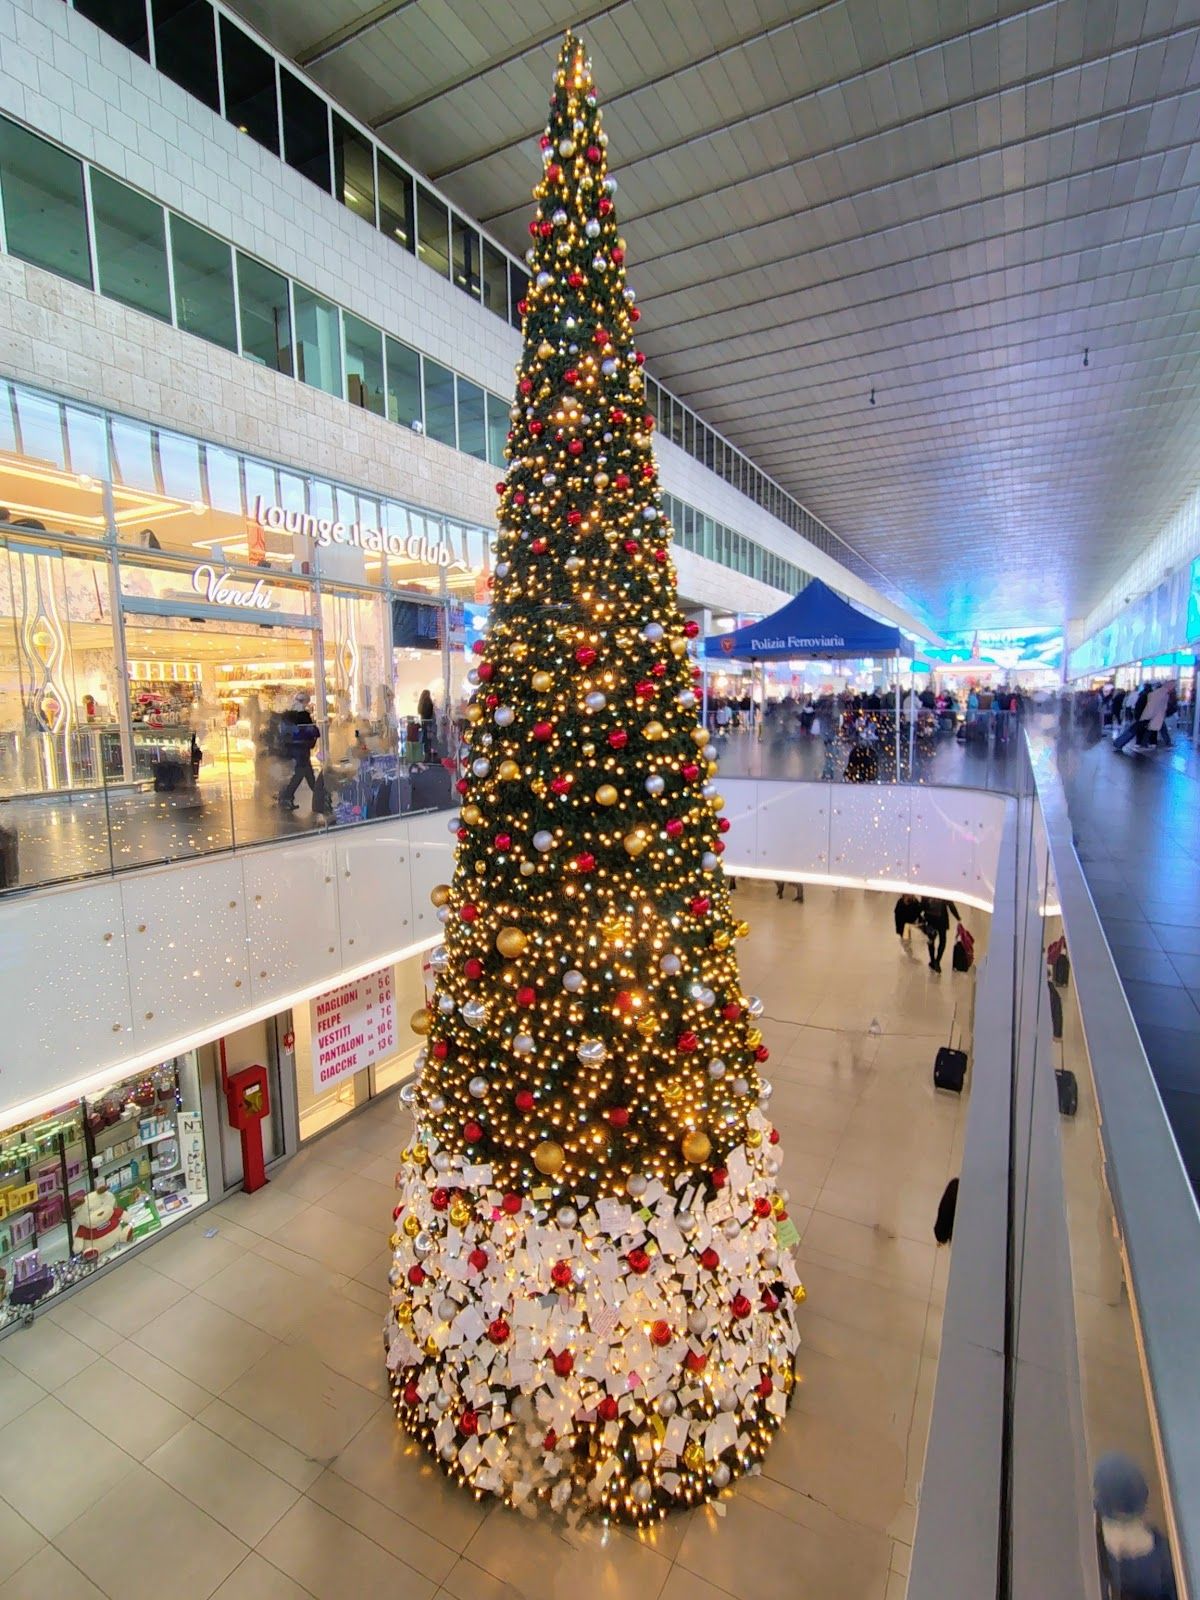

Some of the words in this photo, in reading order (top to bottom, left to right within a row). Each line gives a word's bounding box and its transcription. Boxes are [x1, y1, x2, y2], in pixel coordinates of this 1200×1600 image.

[191, 564, 273, 609] Venchi
[751, 639, 785, 650] Polizia
[787, 635, 844, 648] Ferroviaria
[316, 989, 358, 1017] MAGLIONI
[317, 1012, 341, 1033] FELPE
[318, 1024, 351, 1049] VESTITI
[319, 1034, 364, 1066] PANTALONI
[320, 1053, 358, 1083] GIACCHE
